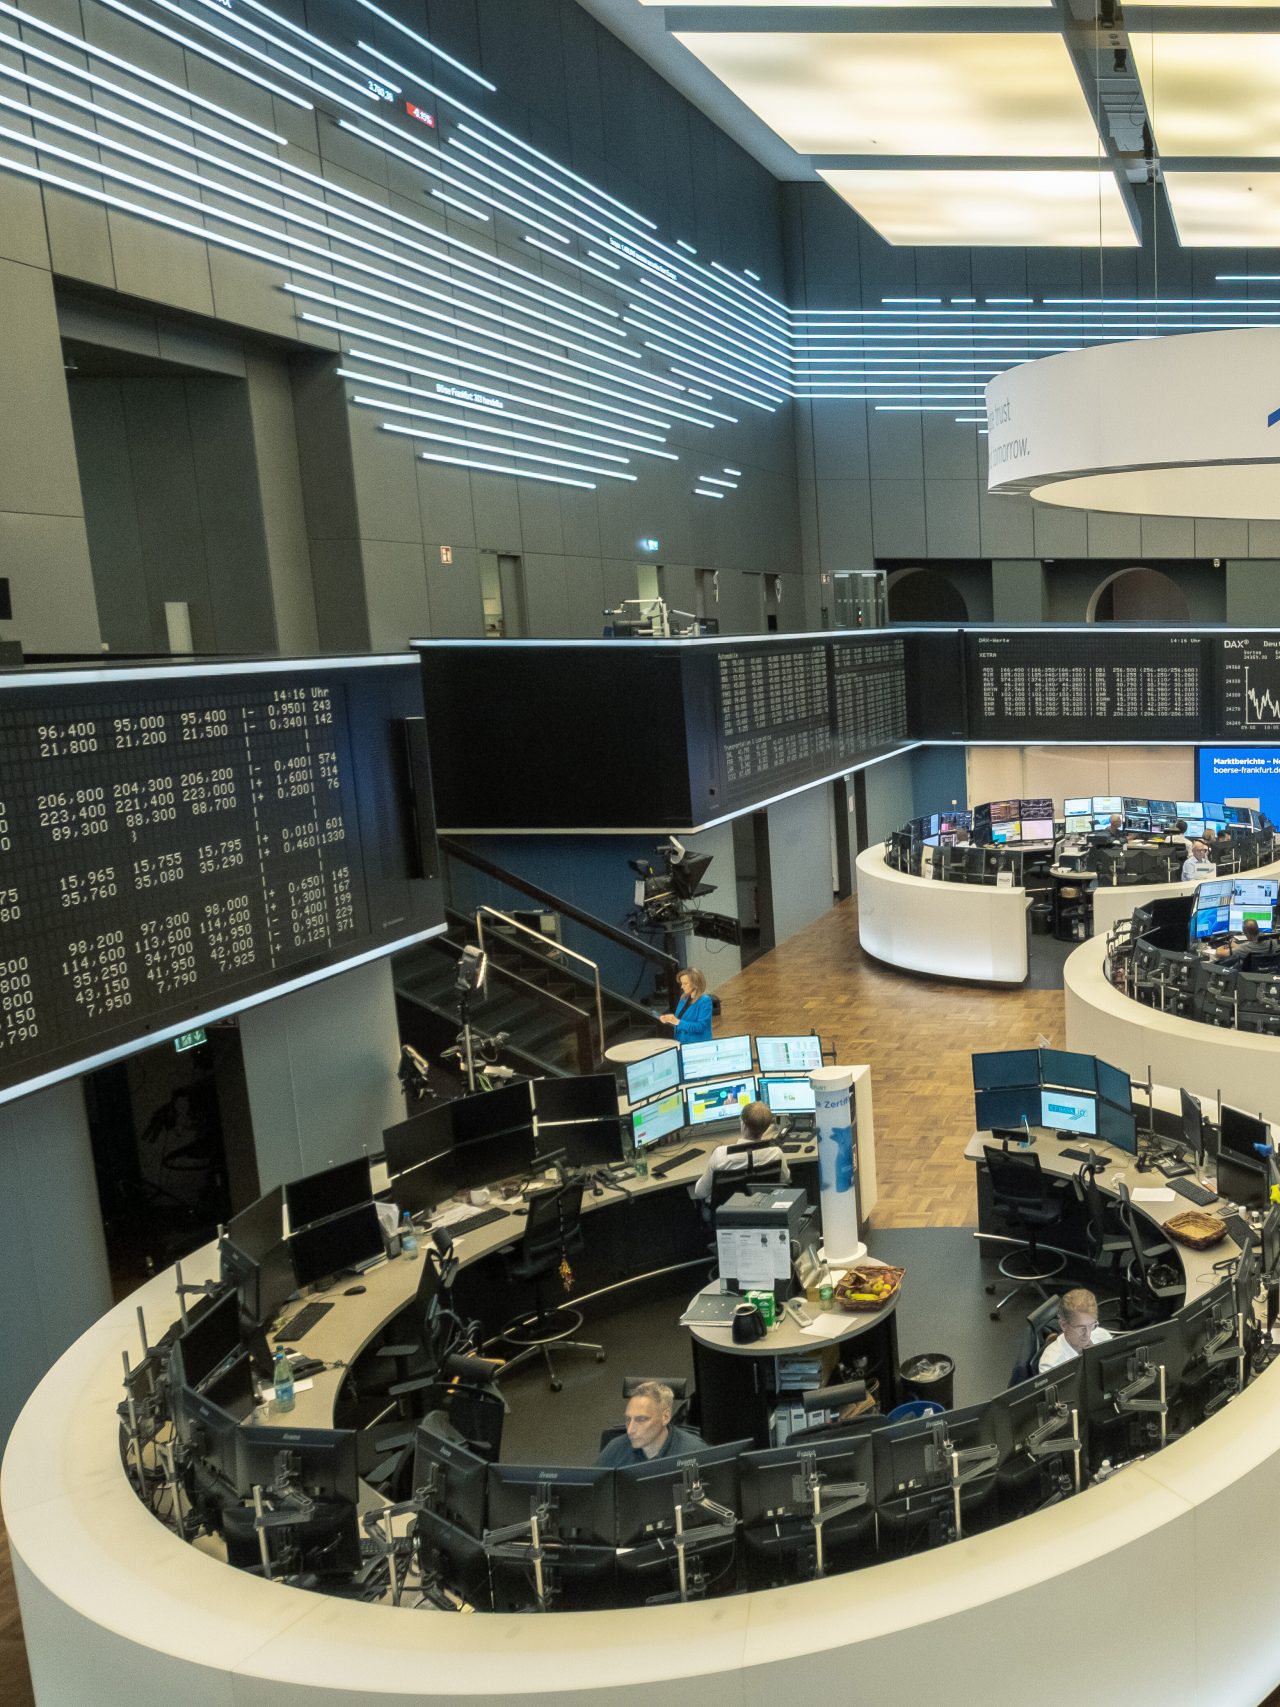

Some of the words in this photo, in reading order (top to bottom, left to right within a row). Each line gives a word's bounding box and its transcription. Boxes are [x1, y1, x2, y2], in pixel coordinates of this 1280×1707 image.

[38, 722, 96, 740] 96,400
[113, 715, 165, 732] 95,000
[181, 709, 226, 725] 95,400
[268, 702, 301, 716] 0,950
[313, 699, 331, 711] 243
[274, 688, 305, 702] 14:16
[311, 687, 329, 698] Uhr
[40, 738, 97, 757] 21,800
[115, 731, 167, 748] 21,200
[182, 724, 228, 740] 21,500
[269, 716, 302, 730] 0,340
[315, 713, 333, 725] 142
[1213, 757, 1265, 765] Marktberichte
[38, 787, 104, 810] 206,800
[113, 776, 173, 797] 204,300
[180, 767, 233, 787] 206,200
[274, 756, 307, 771] 0,400
[318, 752, 336, 764] 574
[39, 803, 106, 826] 223,400
[115, 792, 175, 813] 221,400
[182, 782, 235, 801] 223,000
[277, 770, 308, 785] 1,600
[320, 765, 338, 777] 314
[52, 819, 108, 841] 89,300
[126, 807, 176, 827] 88,300
[192, 796, 237, 815] 88,700
[277, 783, 310, 799] 0,200
[327, 777, 340, 789] 76
[60, 867, 115, 891] 15,965
[133, 852, 183, 874] 15,755
[198, 838, 242, 859] 15,795
[282, 822, 314, 840] 0,010
[325, 816, 343, 829] 601
[61, 883, 117, 908] 35,760
[134, 867, 184, 889] 35,080
[199, 853, 244, 873] 35,290
[283, 836, 315, 853] 0,460
[322, 829, 345, 844] 1330
[62, 946, 126, 975] 114,600
[135, 926, 192, 954] 113,600
[200, 909, 250, 934] 114,600
[291, 888, 321, 907] 1,300
[334, 879, 350, 894] 167
[68, 930, 124, 957] 98,200
[140, 911, 190, 936] 97,300
[204, 895, 249, 917] 98,000
[288, 875, 320, 893] 0,650
[332, 867, 349, 881] 145
[73, 961, 128, 989] 35,250
[145, 941, 194, 966] 34,700
[208, 923, 252, 946] 34,950
[291, 902, 323, 920] 0,400
[335, 892, 352, 906] 199
[75, 977, 130, 1004] 43,150
[147, 956, 195, 981] 41,950
[210, 937, 254, 960] 42,000
[293, 914, 324, 933] 0,950
[336, 905, 353, 919] 229
[86, 992, 132, 1018] 7,950
[157, 970, 197, 994] 7,790
[219, 950, 255, 972] 7,925
[294, 927, 326, 947] 0,125
[337, 918, 354, 932] 371
